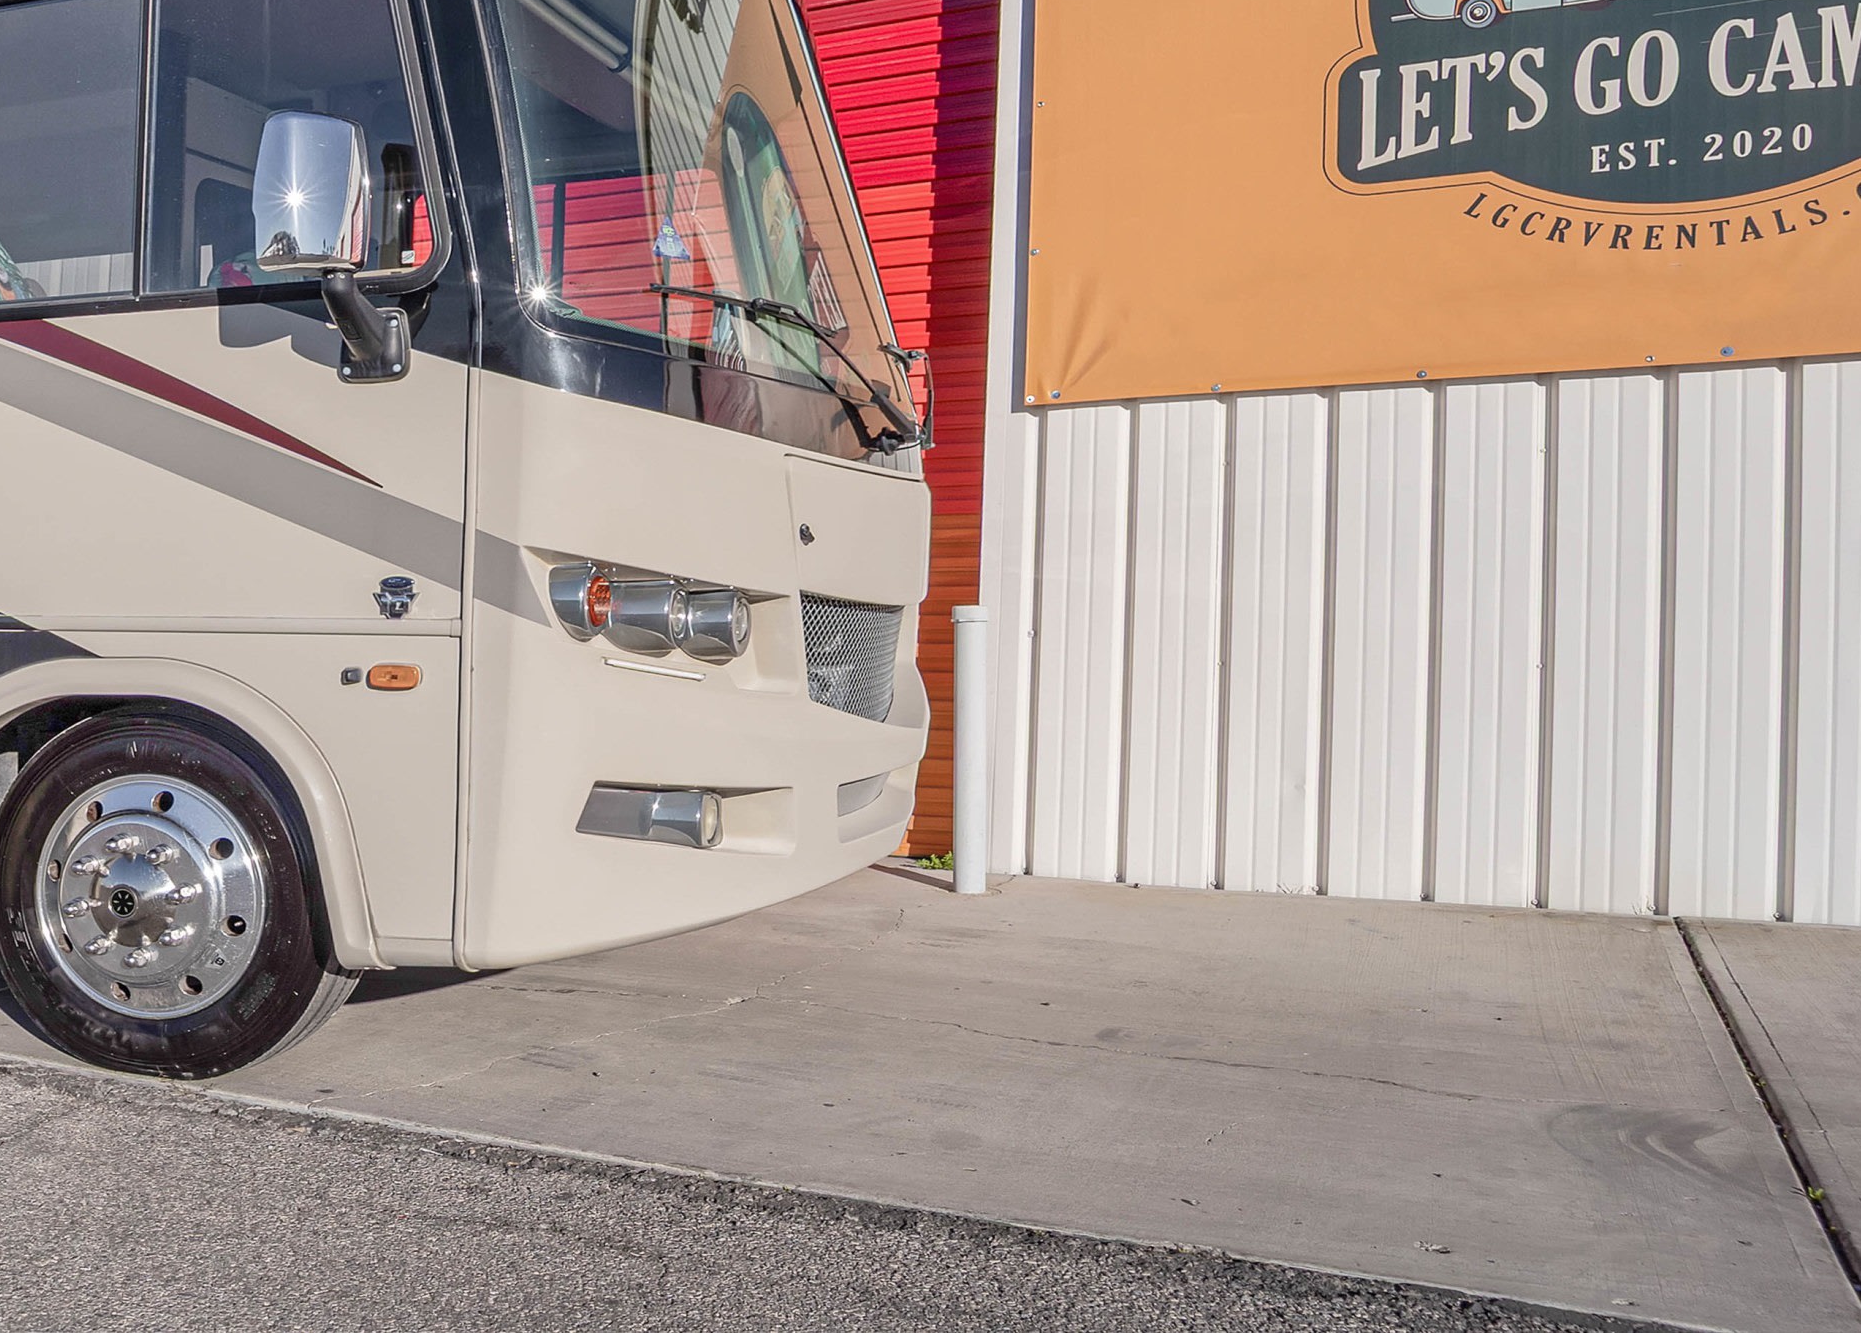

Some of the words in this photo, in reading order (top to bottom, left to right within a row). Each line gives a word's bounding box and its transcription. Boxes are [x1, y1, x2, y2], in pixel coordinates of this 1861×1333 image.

[1356, 46, 1549, 171] LET'S
[1573, 29, 1680, 115] GO
[1590, 137, 1677, 173] EST.
[1702, 123, 1813, 161] 2020
[1463, 181, 1861, 250] LGCRVRENTALS.
